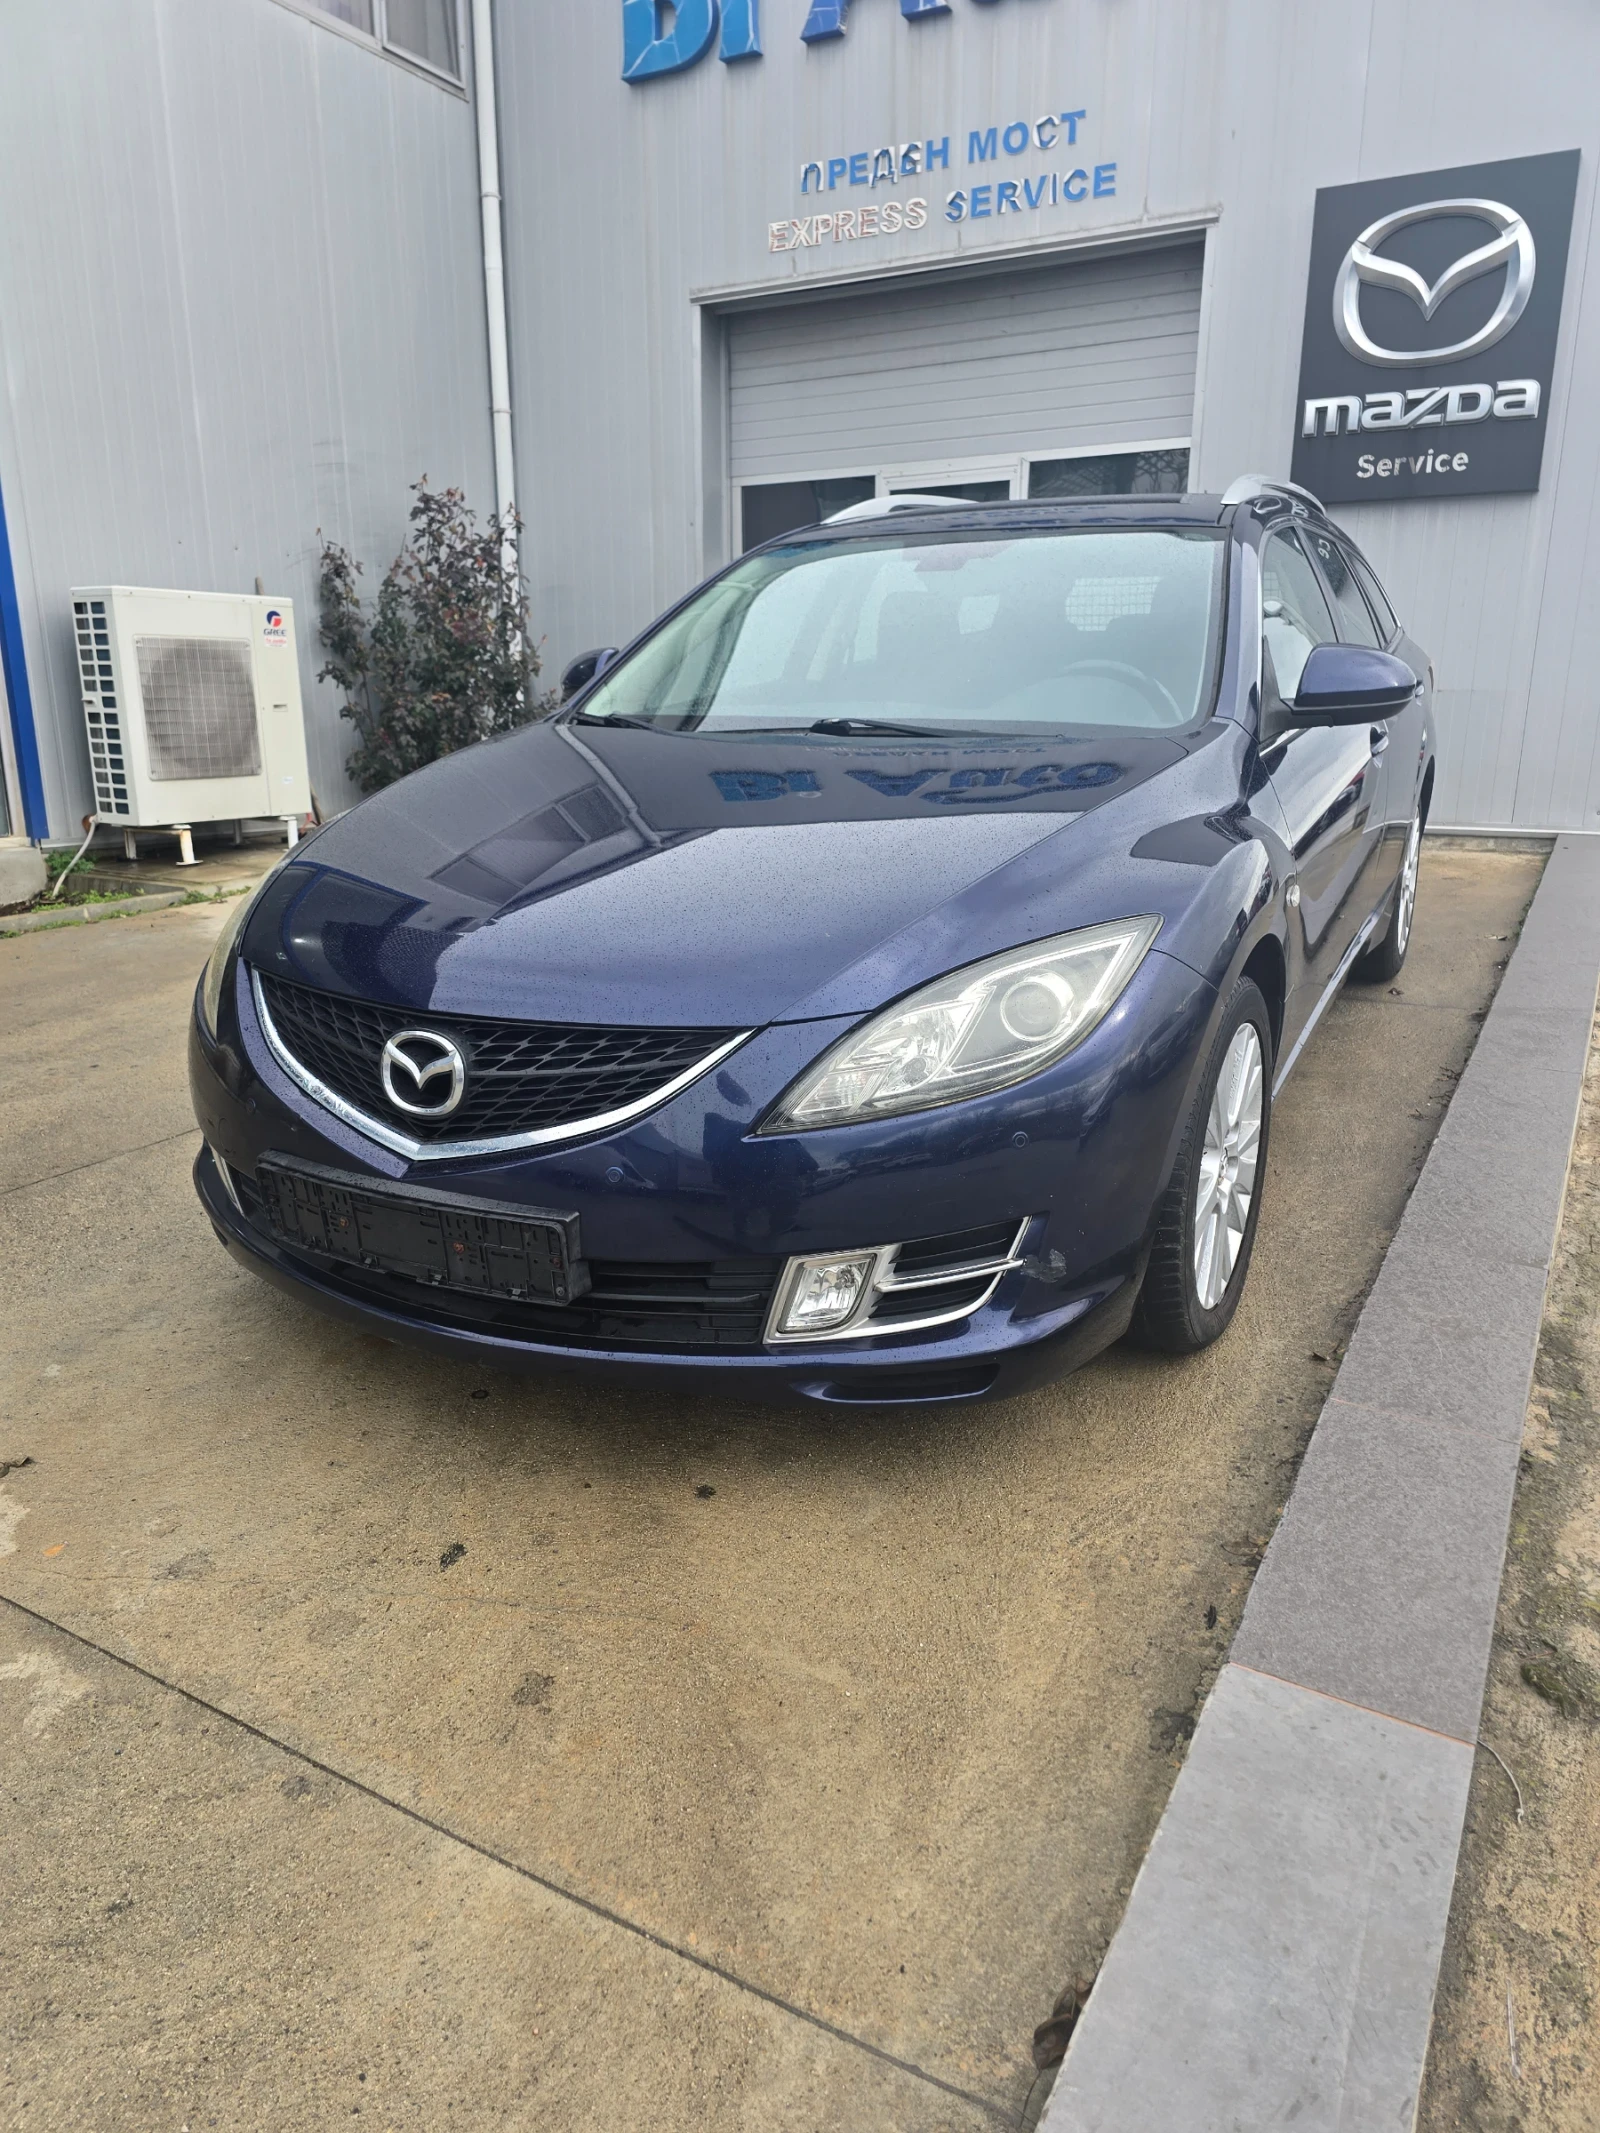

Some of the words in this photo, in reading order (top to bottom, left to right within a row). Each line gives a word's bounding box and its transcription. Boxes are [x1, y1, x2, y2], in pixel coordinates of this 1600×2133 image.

[967, 109, 1087, 163] МОСТ
[768, 198, 928, 252] EXPRESS
[944, 162, 1118, 223] SERVICE
[1356, 449, 1469, 478] Service
